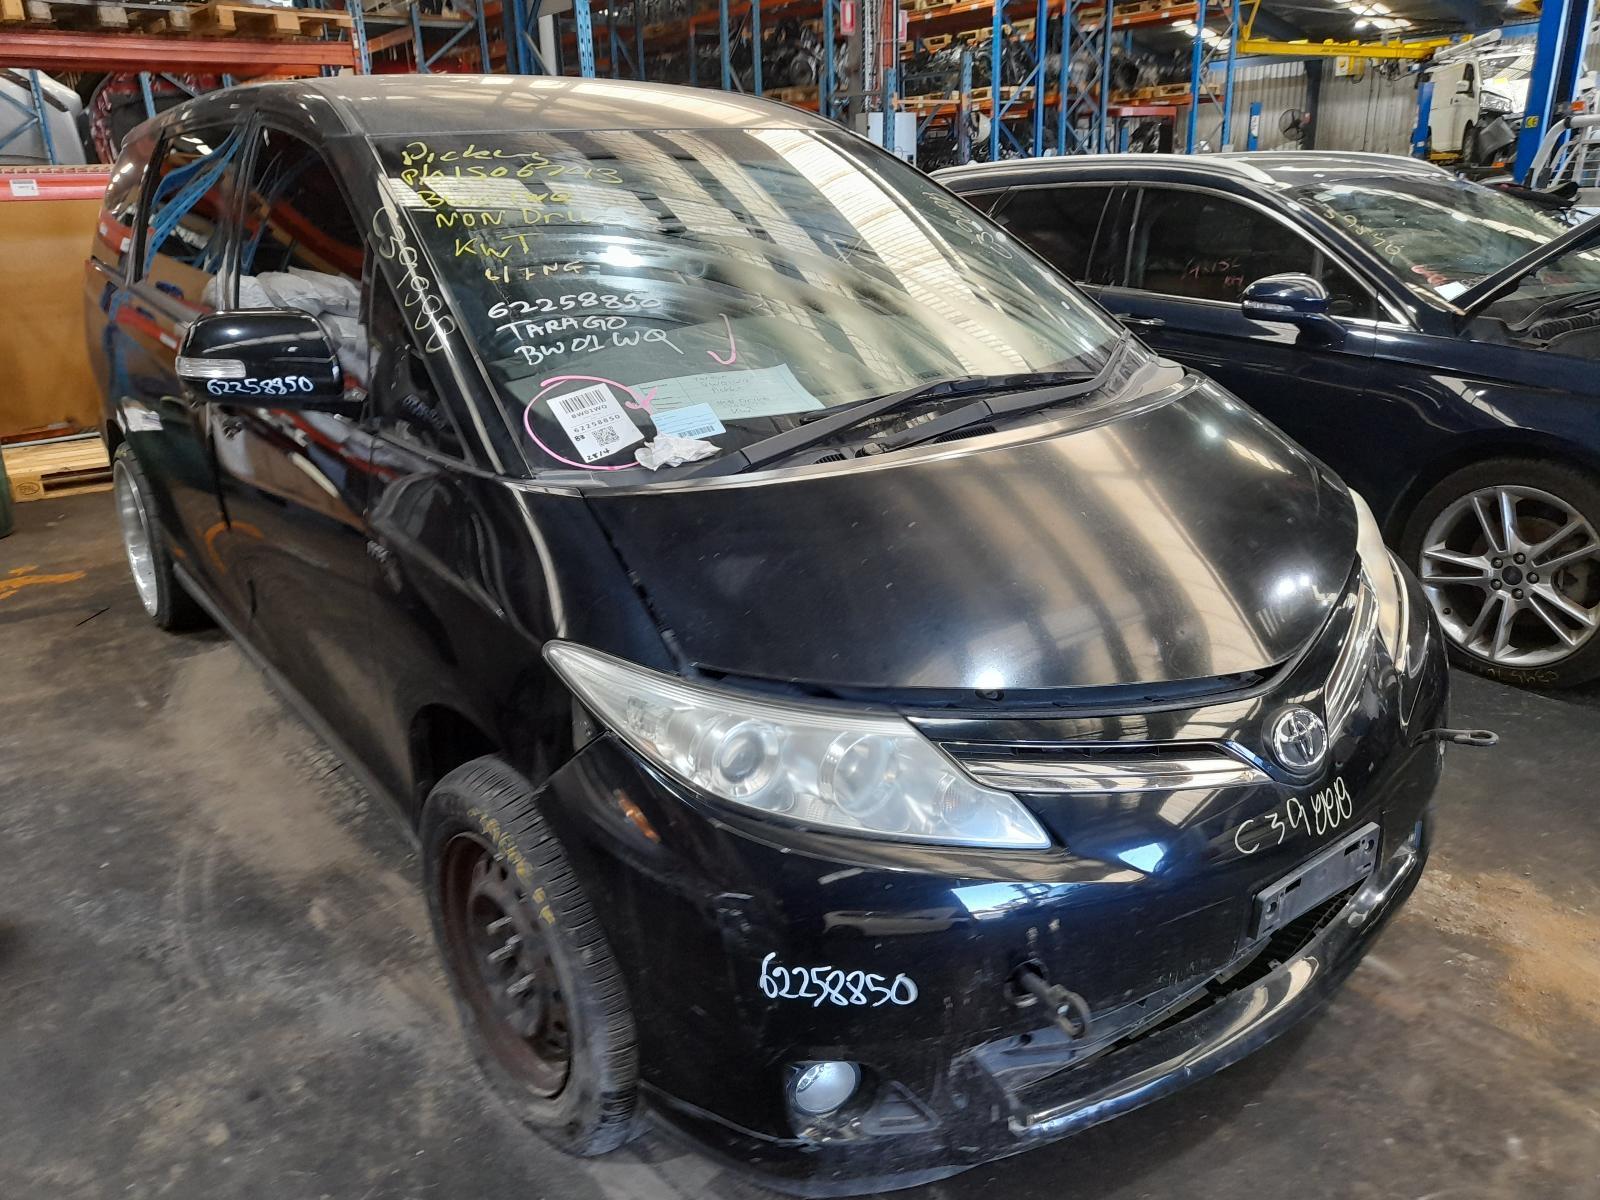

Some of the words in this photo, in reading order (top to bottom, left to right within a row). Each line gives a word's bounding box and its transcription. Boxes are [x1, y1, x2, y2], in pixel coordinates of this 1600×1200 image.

[436, 210, 505, 228] NON
[488, 292, 661, 319] 62258850
[496, 316, 627, 341] TARAGO
[207, 376, 313, 395] 62258850
[571, 404, 608, 419] BW01WQ
[573, 414, 621, 433] 62258850
[760, 951, 919, 1008] 62258850
